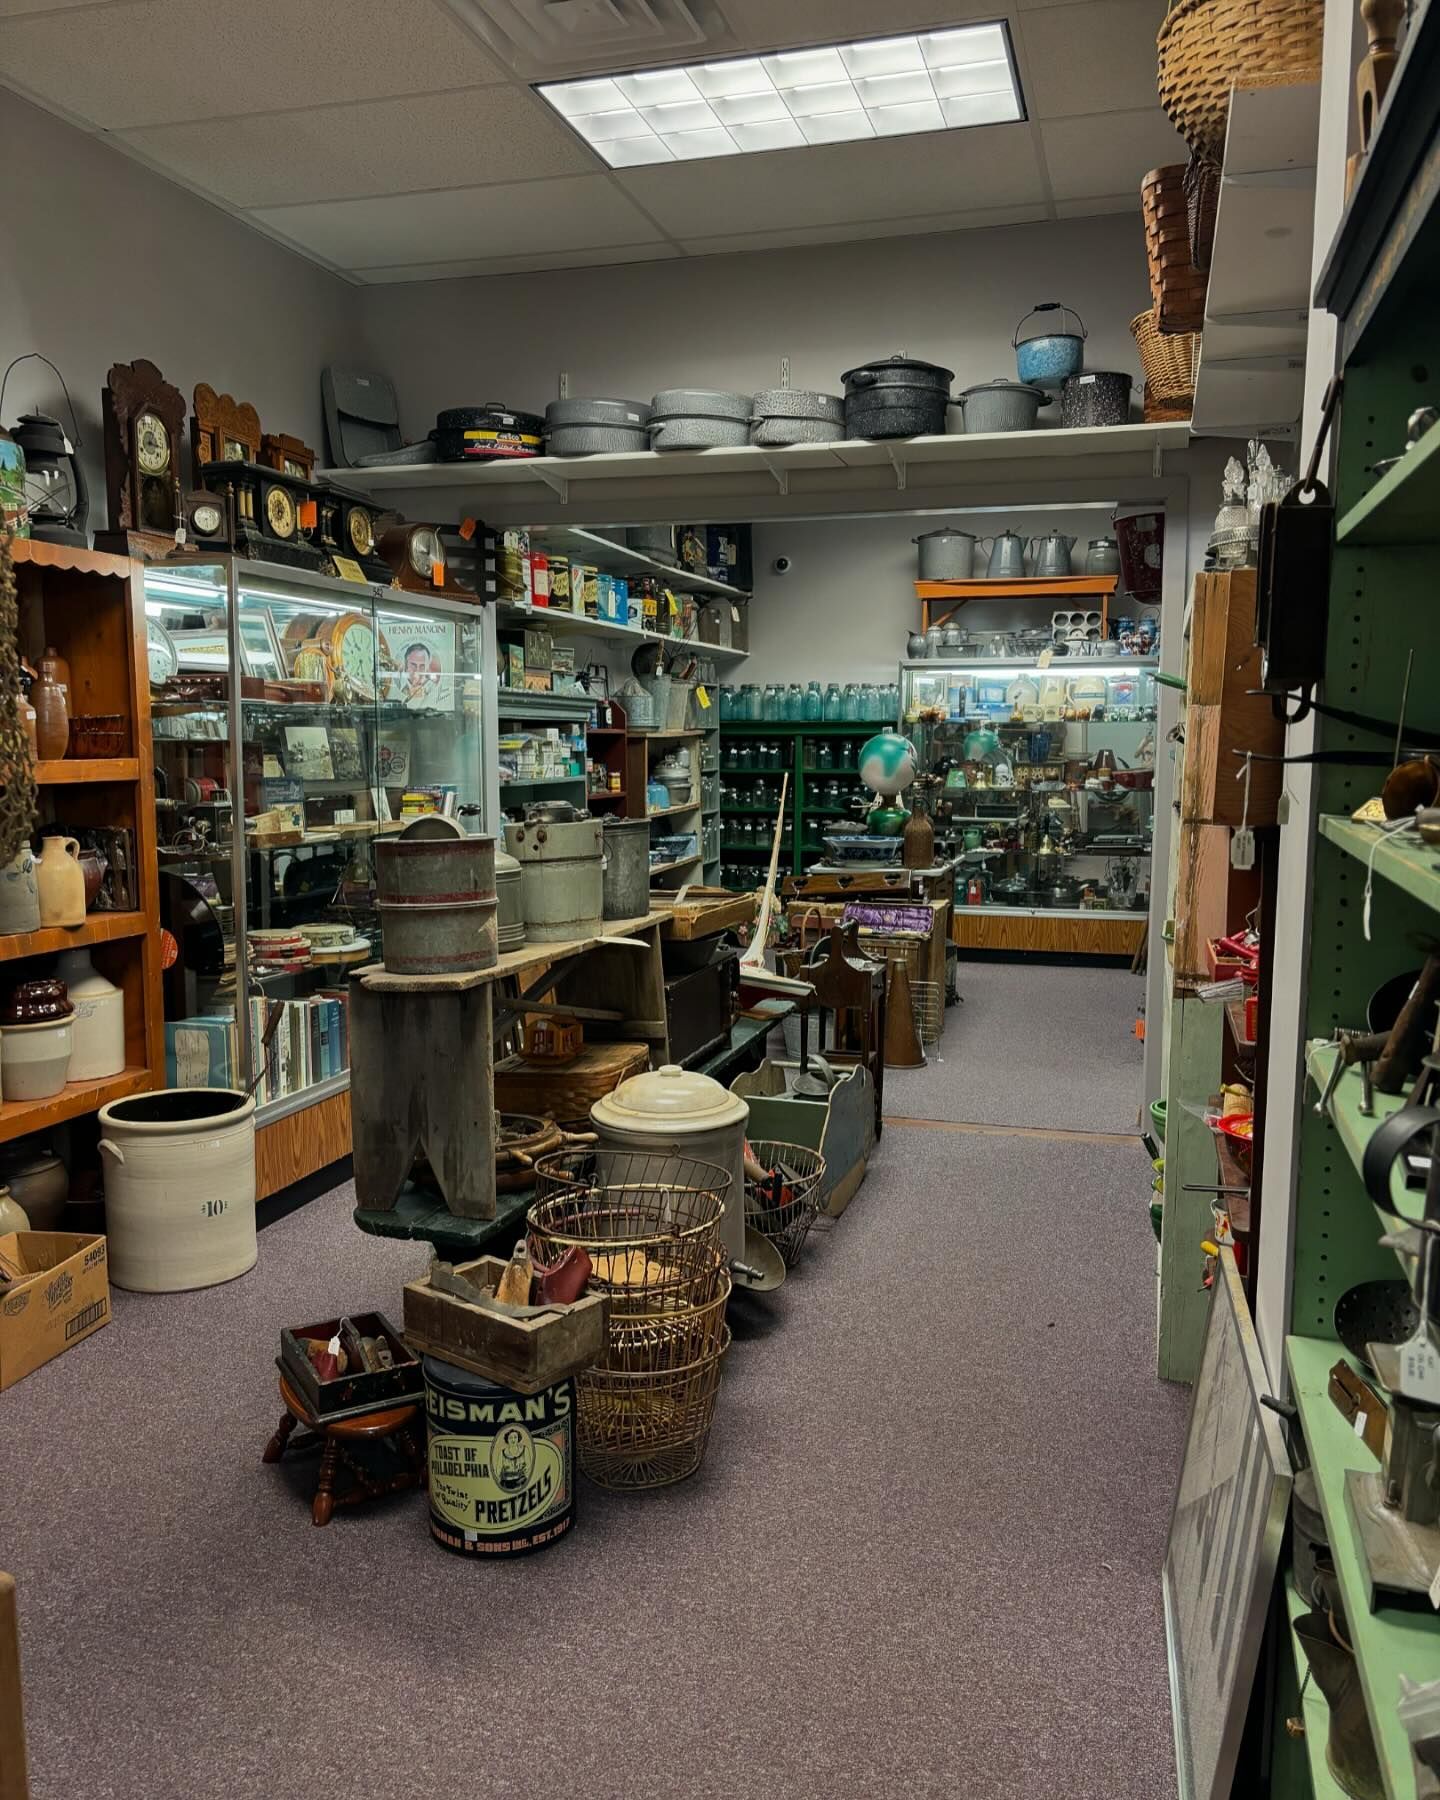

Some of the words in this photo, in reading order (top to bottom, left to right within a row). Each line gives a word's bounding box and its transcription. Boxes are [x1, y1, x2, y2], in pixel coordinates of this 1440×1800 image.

[388, 624, 413, 635] HENRY
[414, 624, 447, 634] MANCINI
[206, 1199, 224, 1218] 10
[425, 1382, 571, 1423] EISMAN'S
[434, 1445, 460, 1461] TOAST
[464, 1447, 478, 1462] OF
[431, 1460, 490, 1478] PHILADELPHIA
[475, 1464, 552, 1524] PRETZELS
[476, 1541, 511, 1552] SONS
